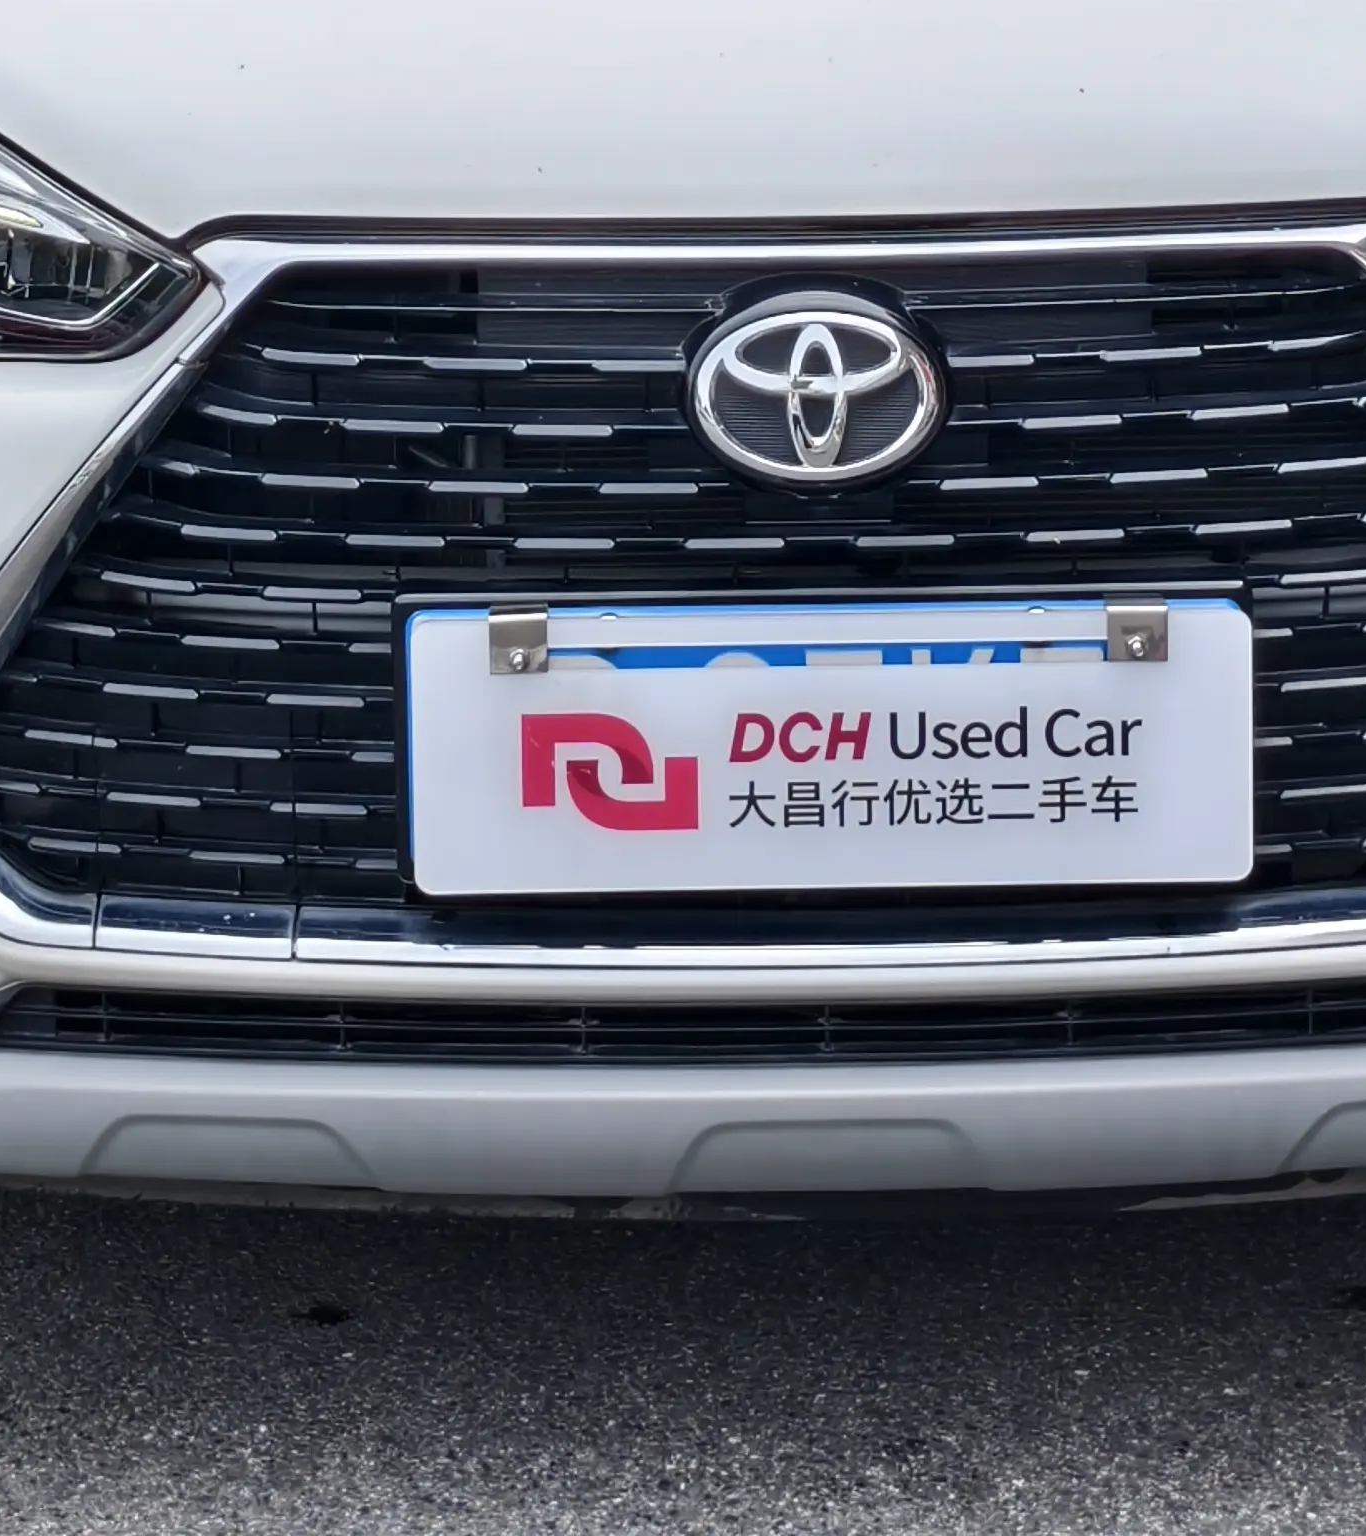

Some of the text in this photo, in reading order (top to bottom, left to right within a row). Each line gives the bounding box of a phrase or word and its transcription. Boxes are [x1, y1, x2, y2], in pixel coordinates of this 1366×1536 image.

[728, 706, 1143, 763] DCH Used Car
[728, 775, 1140, 829] 大昌行优选二手车
